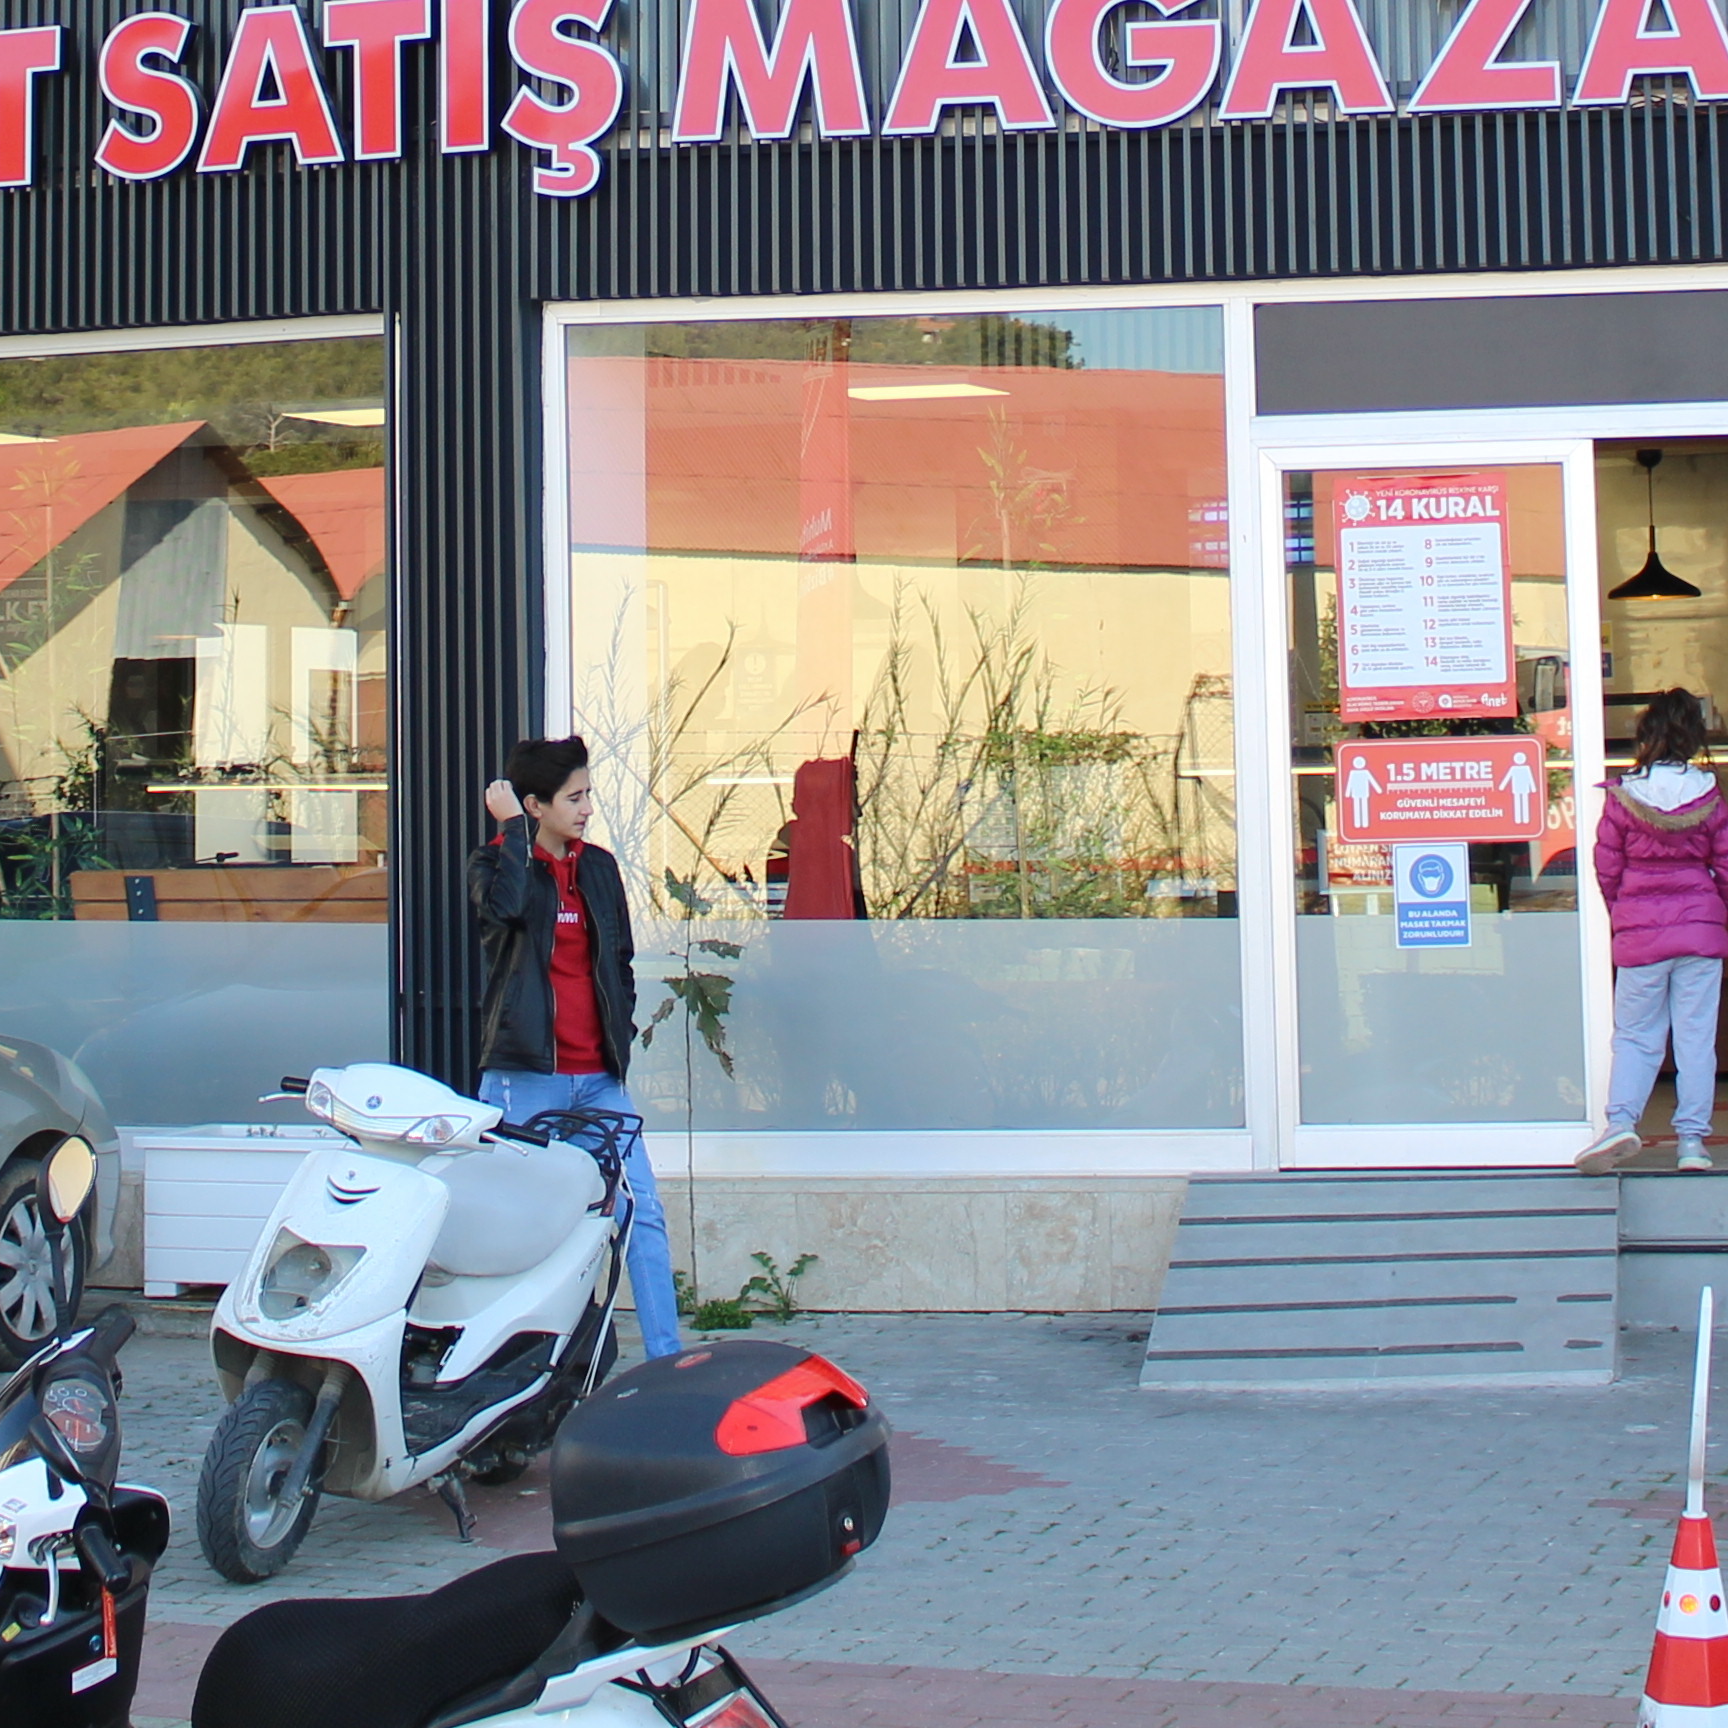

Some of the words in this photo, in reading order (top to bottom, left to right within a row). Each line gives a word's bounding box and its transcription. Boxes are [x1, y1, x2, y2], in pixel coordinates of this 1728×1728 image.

[1376, 498, 1405, 521] 14
[1411, 495, 1500, 520] KURAL
[1349, 541, 1355, 552] 1
[1424, 538, 1432, 549] 8
[1348, 559, 1355, 570] 2
[1425, 557, 1433, 568] 9
[1348, 578, 1356, 589] 3
[1419, 575, 1434, 586] 10
[1422, 596, 1434, 606] 11
[1350, 605, 1358, 615] 4
[1350, 624, 1358, 635] 5
[1423, 619, 1436, 630] 12
[1424, 637, 1437, 648] 13
[1351, 645, 1359, 655] 6
[1424, 656, 1438, 667] 14
[1352, 663, 1359, 673] 7
[1386, 762, 1415, 781] 1.5
[1421, 760, 1493, 780] METRE
[1396, 797, 1437, 808] GÜVENLİ
[1438, 796, 1486, 807] MESAFEYİ
[1379, 809, 1431, 820] KORUMAYA
[1433, 807, 1467, 819] DİKKAT
[1468, 807, 1503, 818] EDELİM
[1408, 910, 1421, 918] BU
[1421, 909, 1458, 918] ALANDA
[1400, 921, 1430, 929] MASKE
[1431, 920, 1466, 928] TAKMAK
